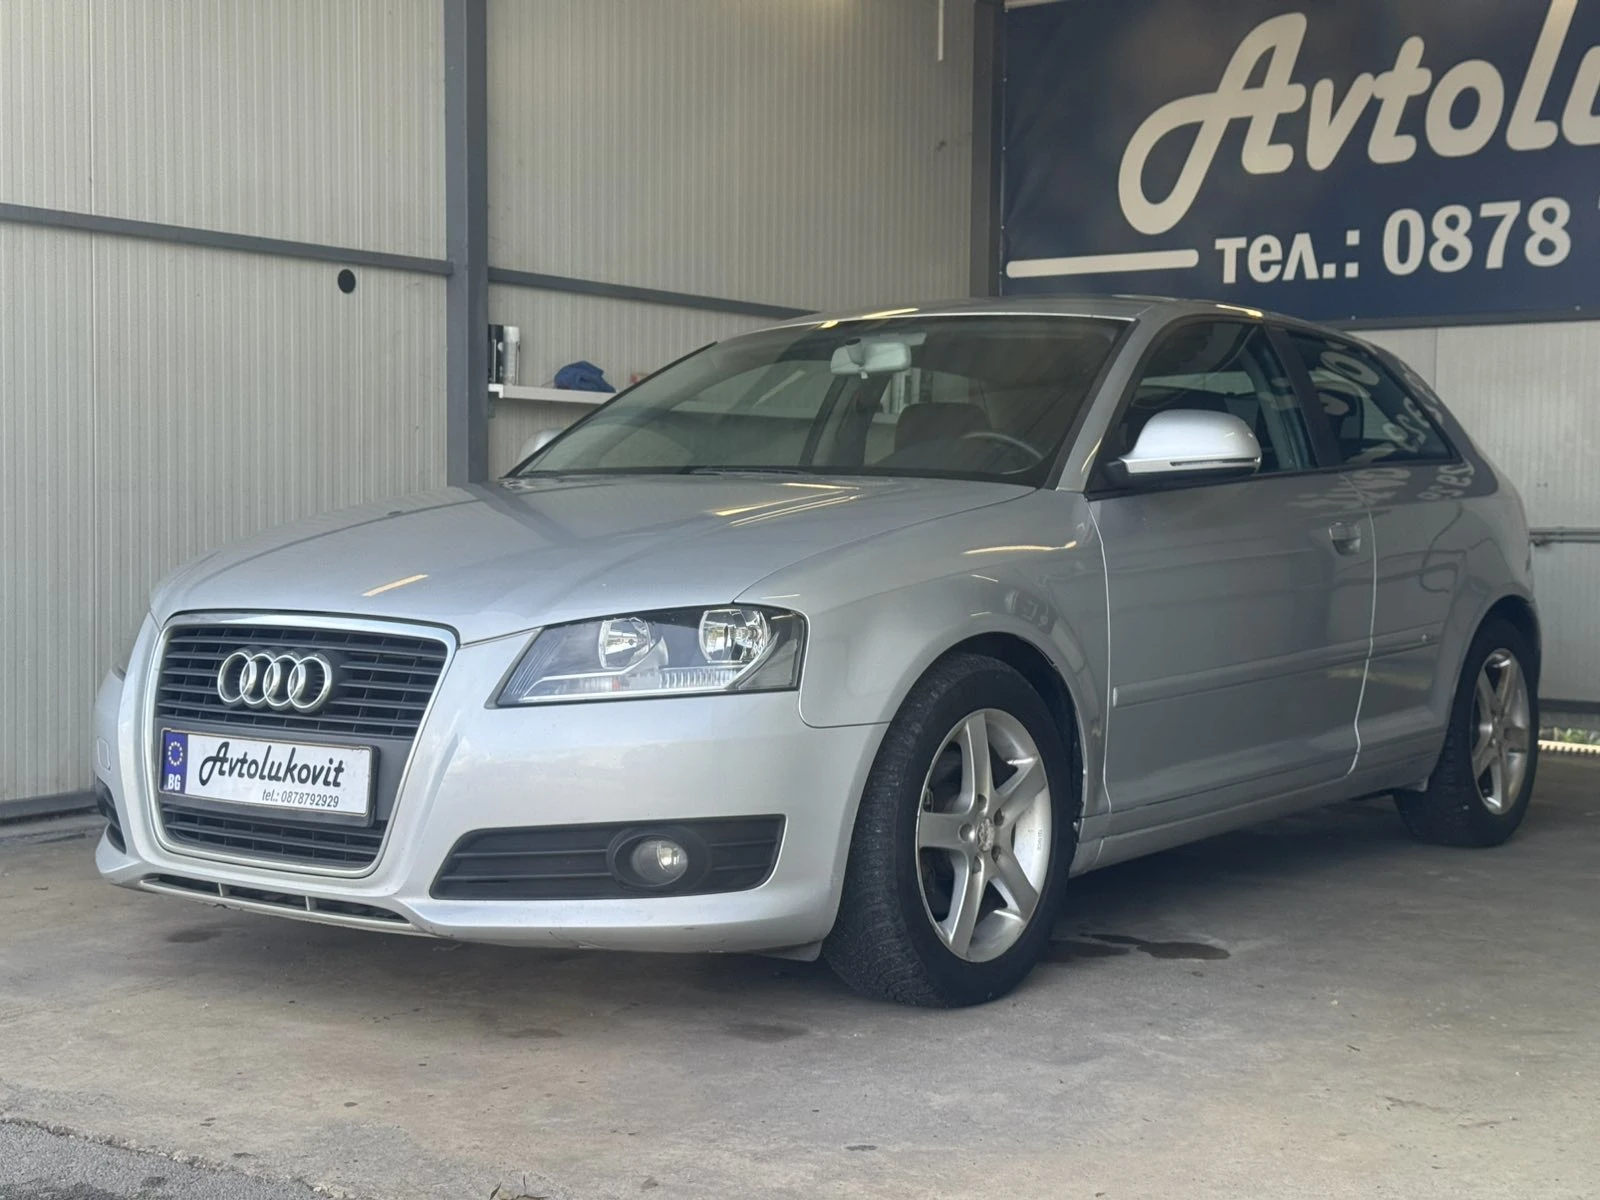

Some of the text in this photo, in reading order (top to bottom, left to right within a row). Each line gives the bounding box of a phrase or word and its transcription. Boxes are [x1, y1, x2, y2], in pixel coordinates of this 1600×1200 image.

[1214, 197, 1572, 284] тел.: 0878
[198, 741, 345, 788] Avtolukovit
[167, 773, 182, 791] BG
[280, 790, 340, 808] 0878792929
